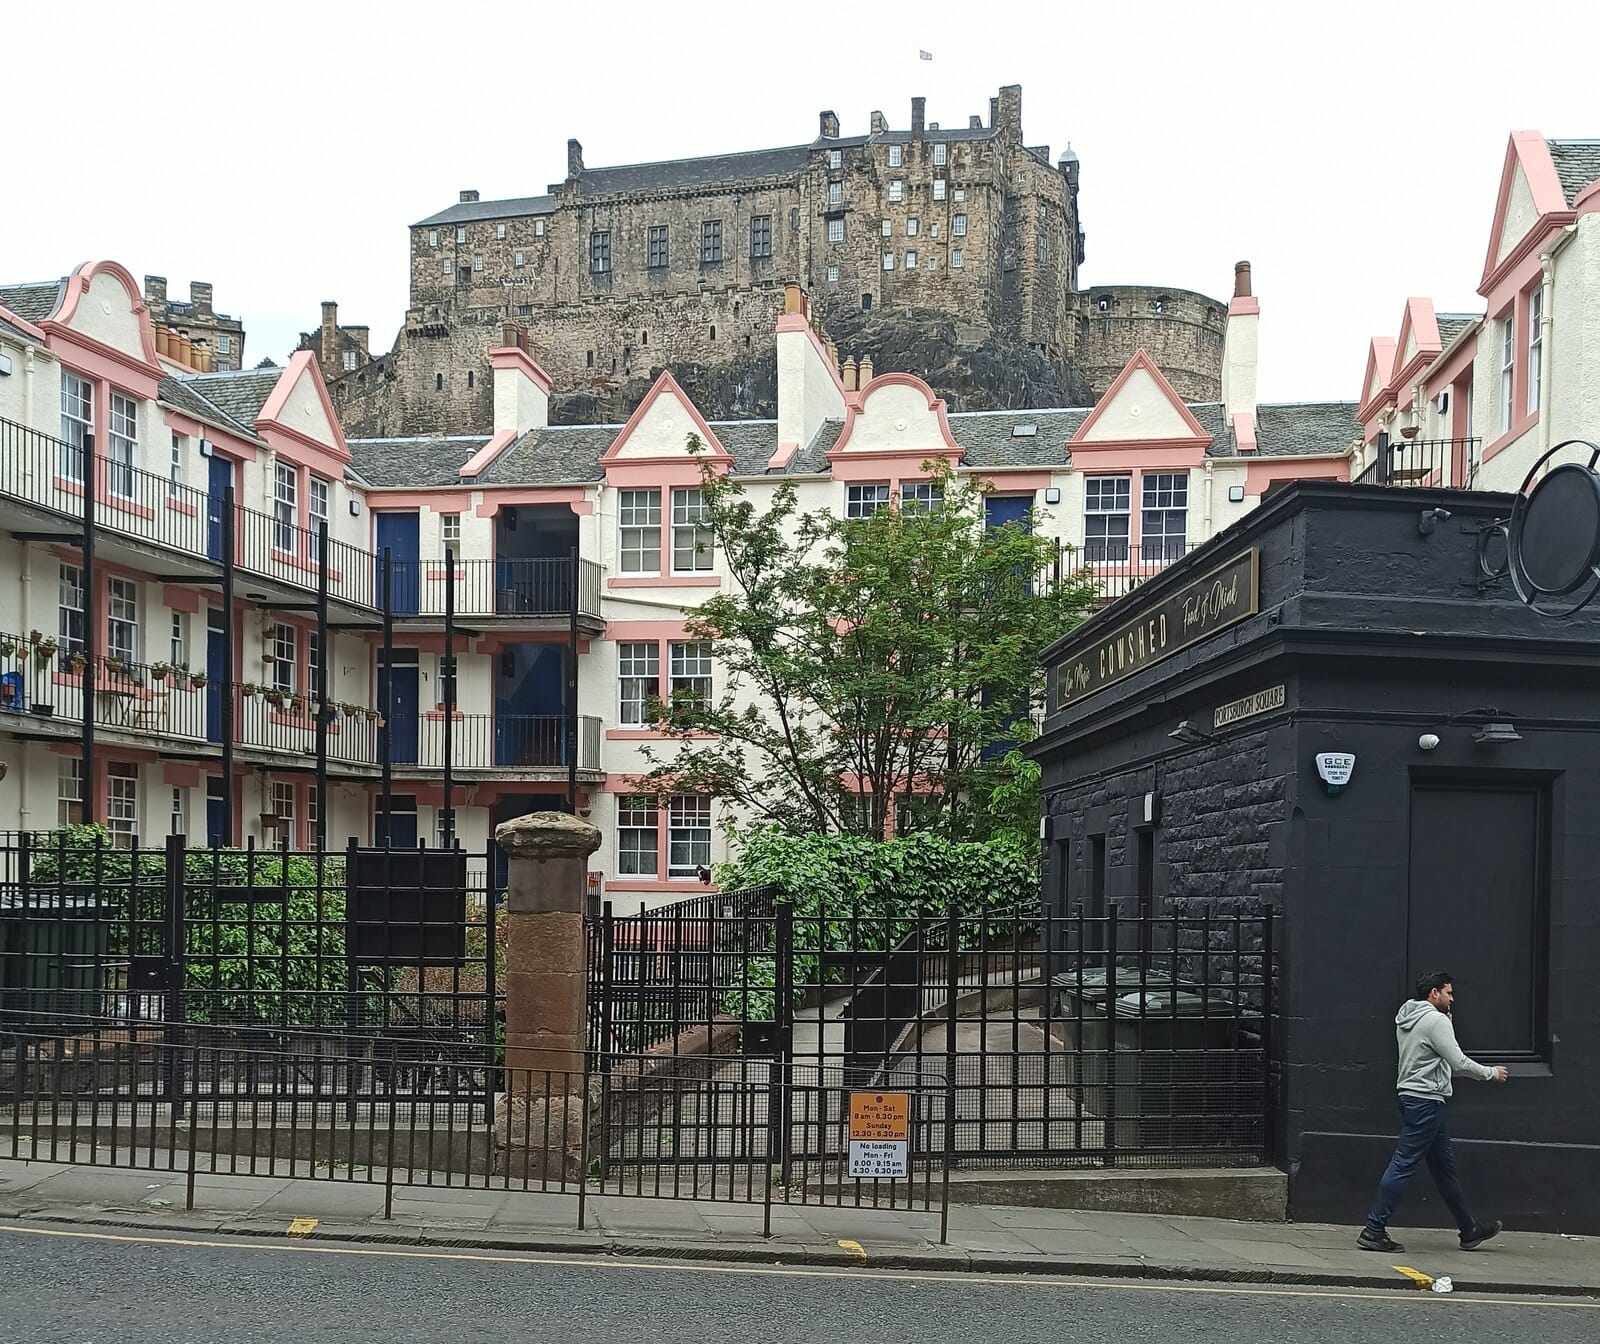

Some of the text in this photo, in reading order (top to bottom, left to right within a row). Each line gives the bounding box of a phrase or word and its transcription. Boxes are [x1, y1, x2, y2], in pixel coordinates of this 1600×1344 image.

[1100, 614, 1166, 679] COWSHED
[1182, 595, 1200, 636] Food
[1200, 592, 1210, 627] &
[1210, 574, 1238, 619] Drink
[1215, 687, 1284, 725] PORTSBURGH SQUARE
[866, 1122, 892, 1130] Sunday
